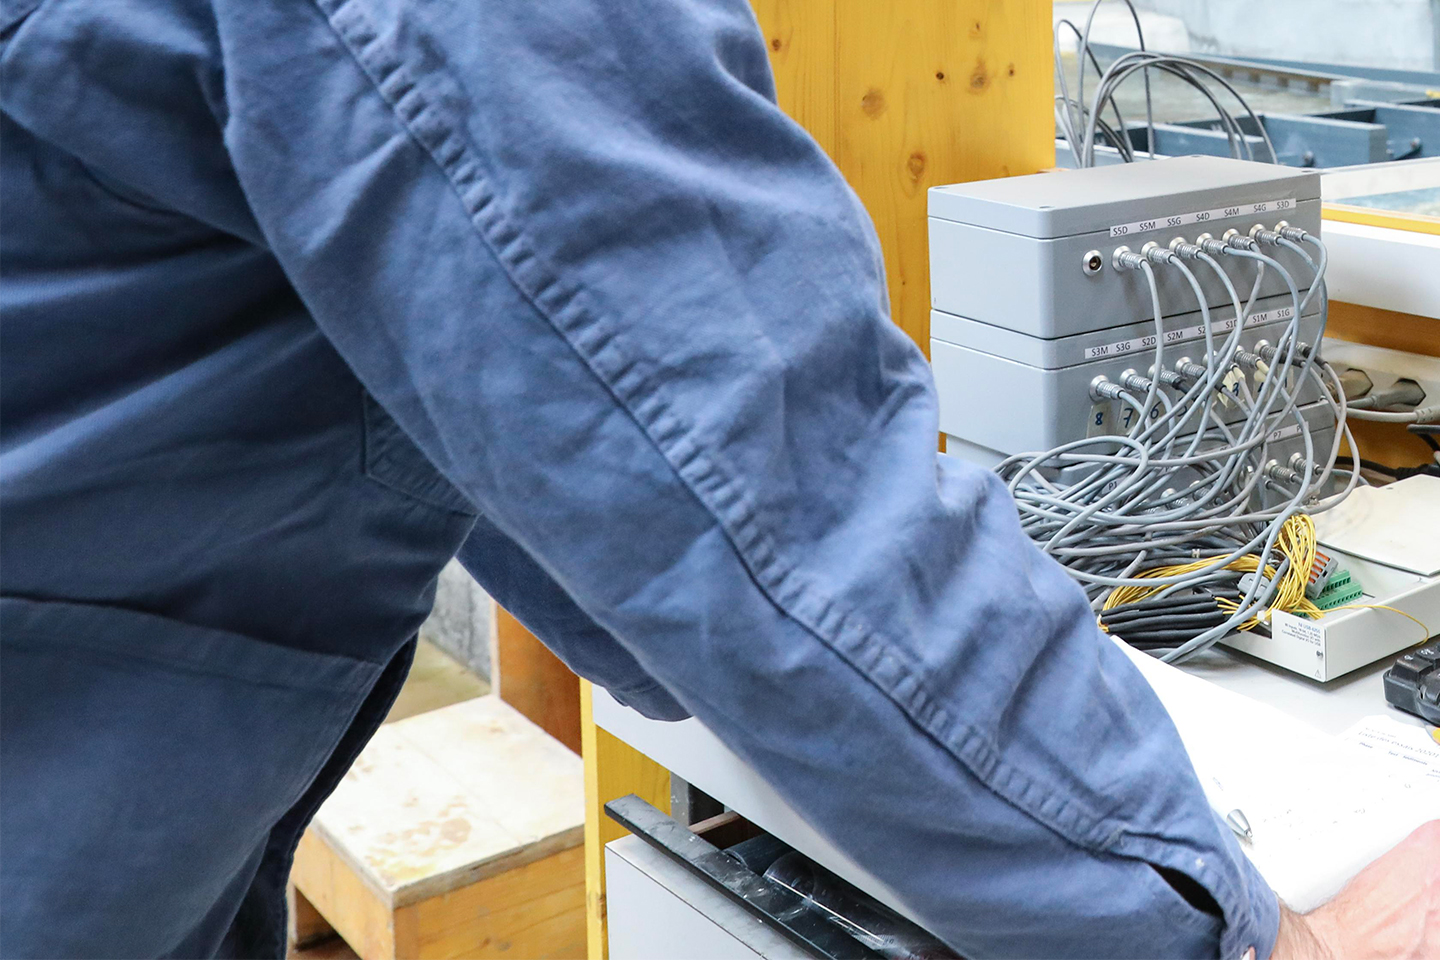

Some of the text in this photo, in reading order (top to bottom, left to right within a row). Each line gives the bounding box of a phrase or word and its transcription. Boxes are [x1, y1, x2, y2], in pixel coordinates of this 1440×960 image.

[1113, 200, 1290, 236] S5D S5M S5G S4D S4M S4G S3D
[1091, 346, 1109, 357] S3M
[1116, 342, 1131, 353] S3G
[1142, 336, 1157, 347] S2D
[1167, 331, 1183, 341] S2M
[1197, 326, 1206, 335] S2
[1252, 312, 1268, 323] S1M
[1277, 308, 1290, 318] S1G
[1094, 411, 1103, 426] 8
[1123, 407, 1133, 429] 7
